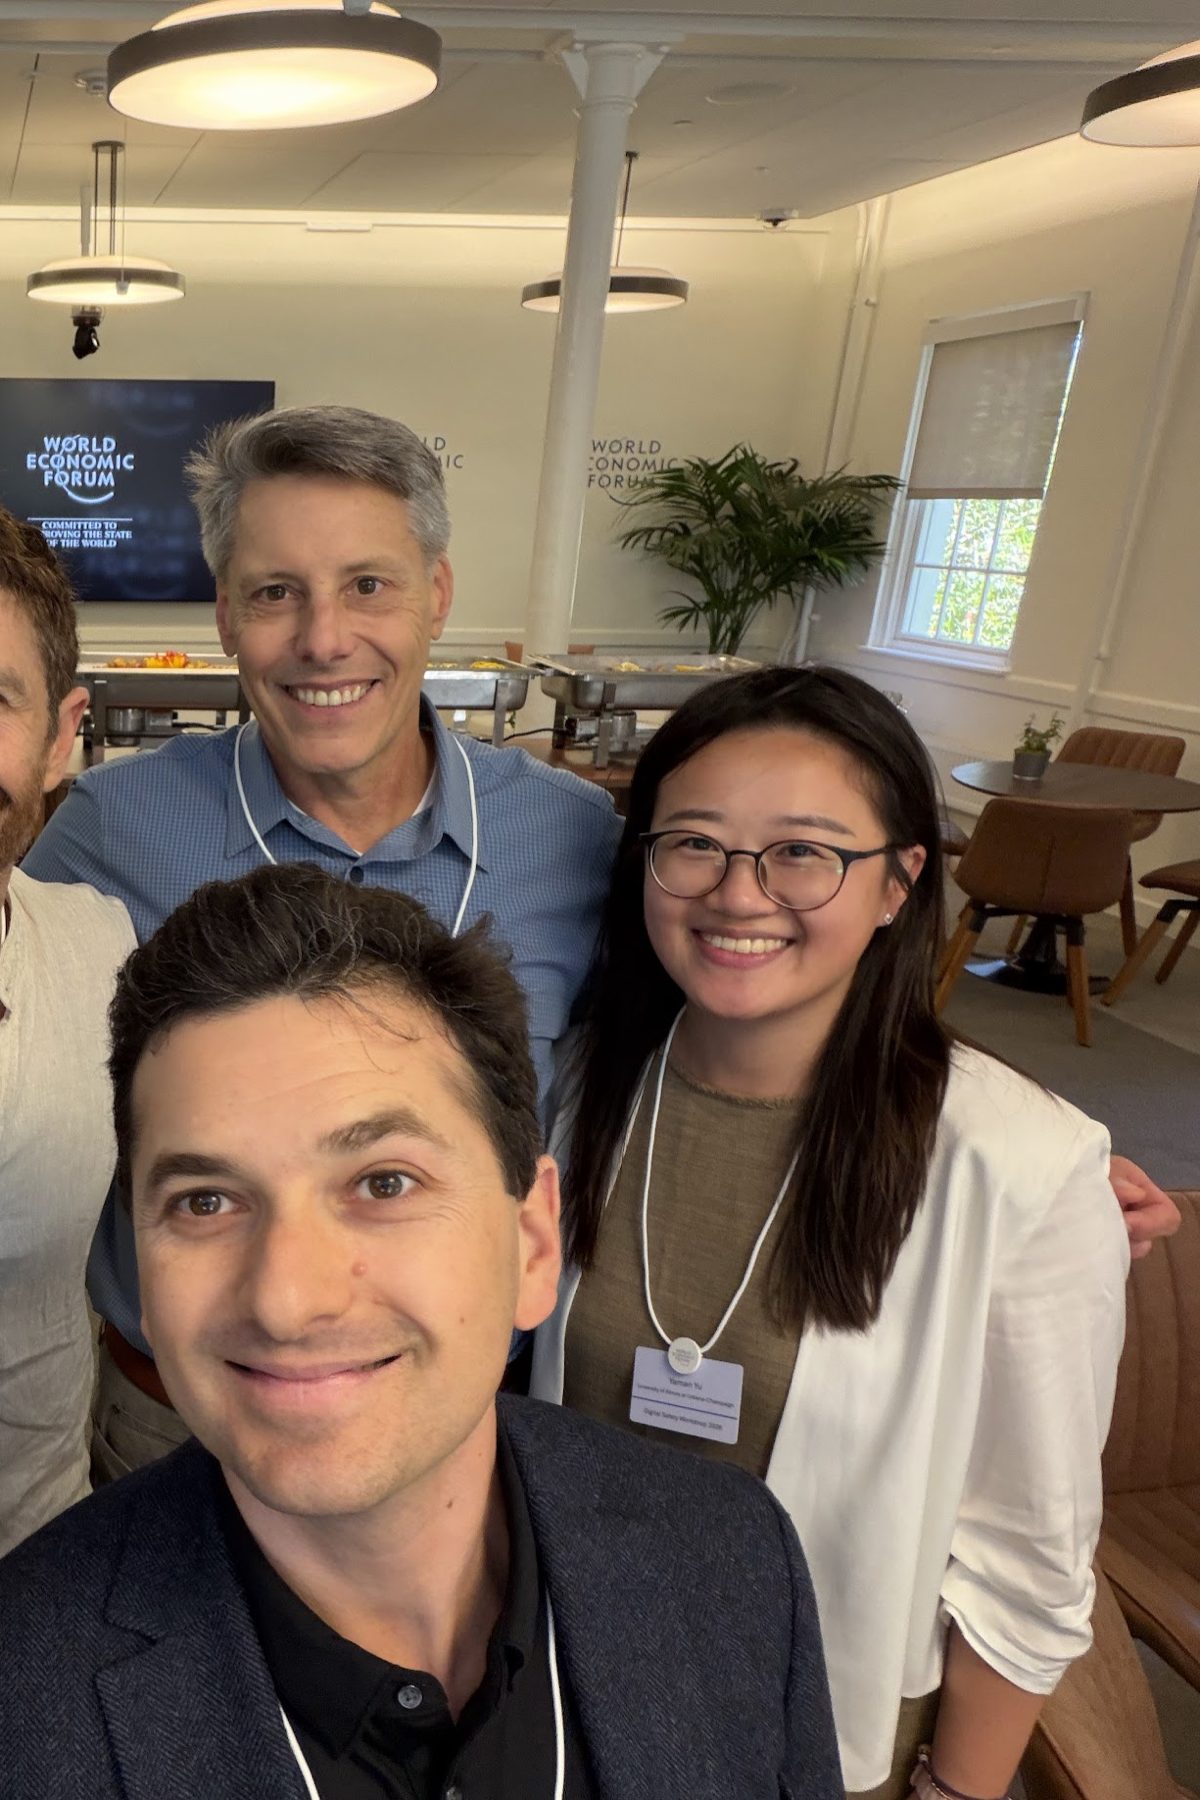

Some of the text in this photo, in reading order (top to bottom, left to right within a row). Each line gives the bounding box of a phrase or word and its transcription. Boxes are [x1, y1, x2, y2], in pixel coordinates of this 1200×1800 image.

[43, 436, 116, 453] WORLD
[592, 440, 661, 454] WORLD
[26, 453, 135, 470] ECONOMIC
[43, 471, 115, 487] FORUM
[41, 521, 118, 530] COMMITTED TO
[82, 530, 103, 539] THE
[104, 530, 133, 539] STATE
[60, 540, 80, 548] THE
[81, 540, 117, 548] WORLD
